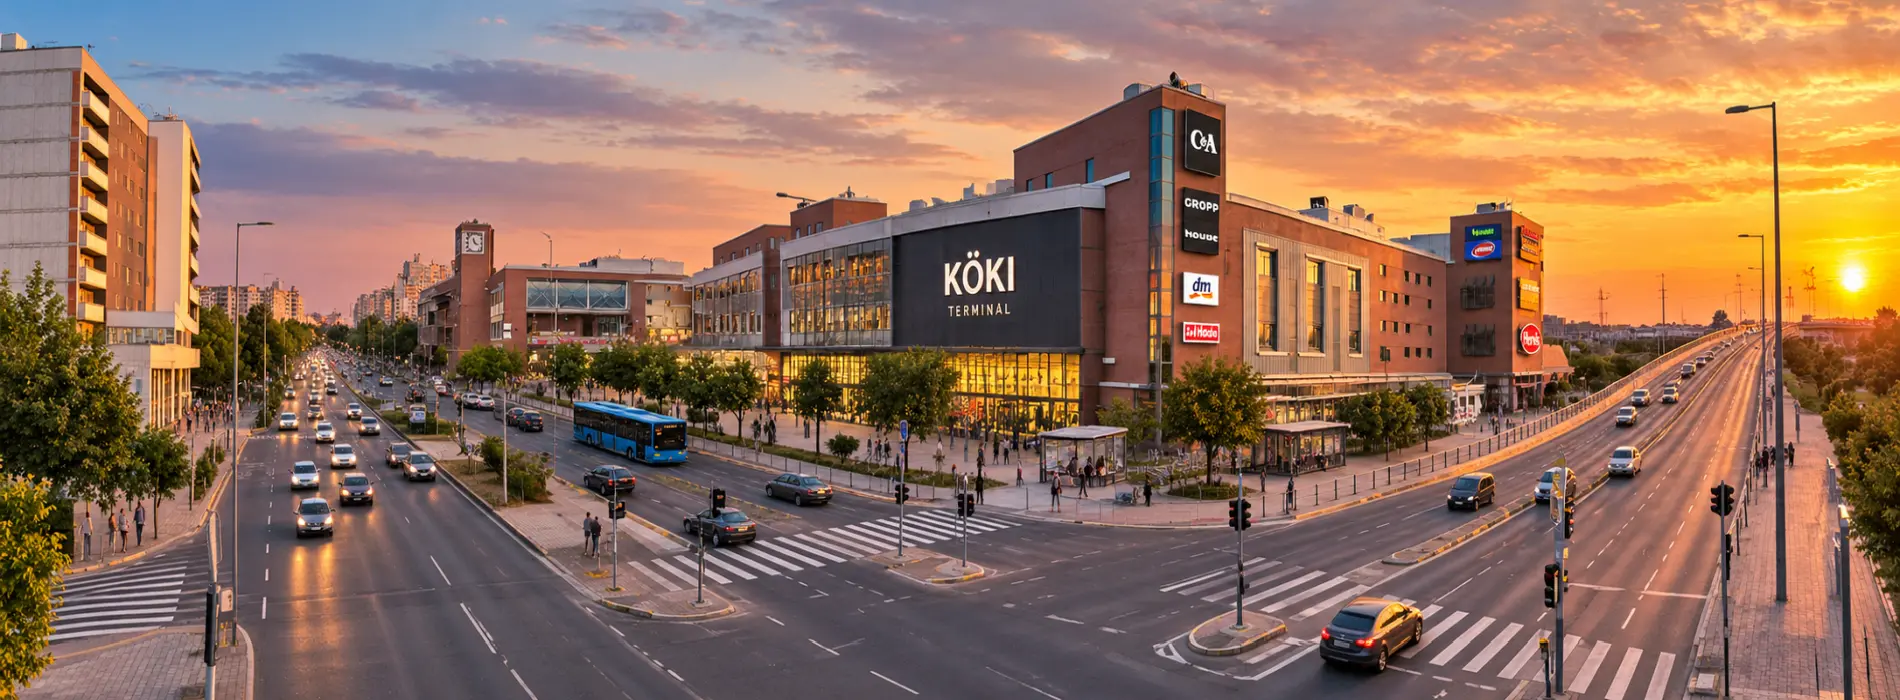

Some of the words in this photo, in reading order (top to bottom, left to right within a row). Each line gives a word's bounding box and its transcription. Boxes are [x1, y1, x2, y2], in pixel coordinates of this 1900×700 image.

[1190, 129, 1218, 155] C&A
[944, 250, 1015, 296] KÖKI
[1192, 276, 1211, 293] dm
[947, 302, 1011, 317] TERMINAL
